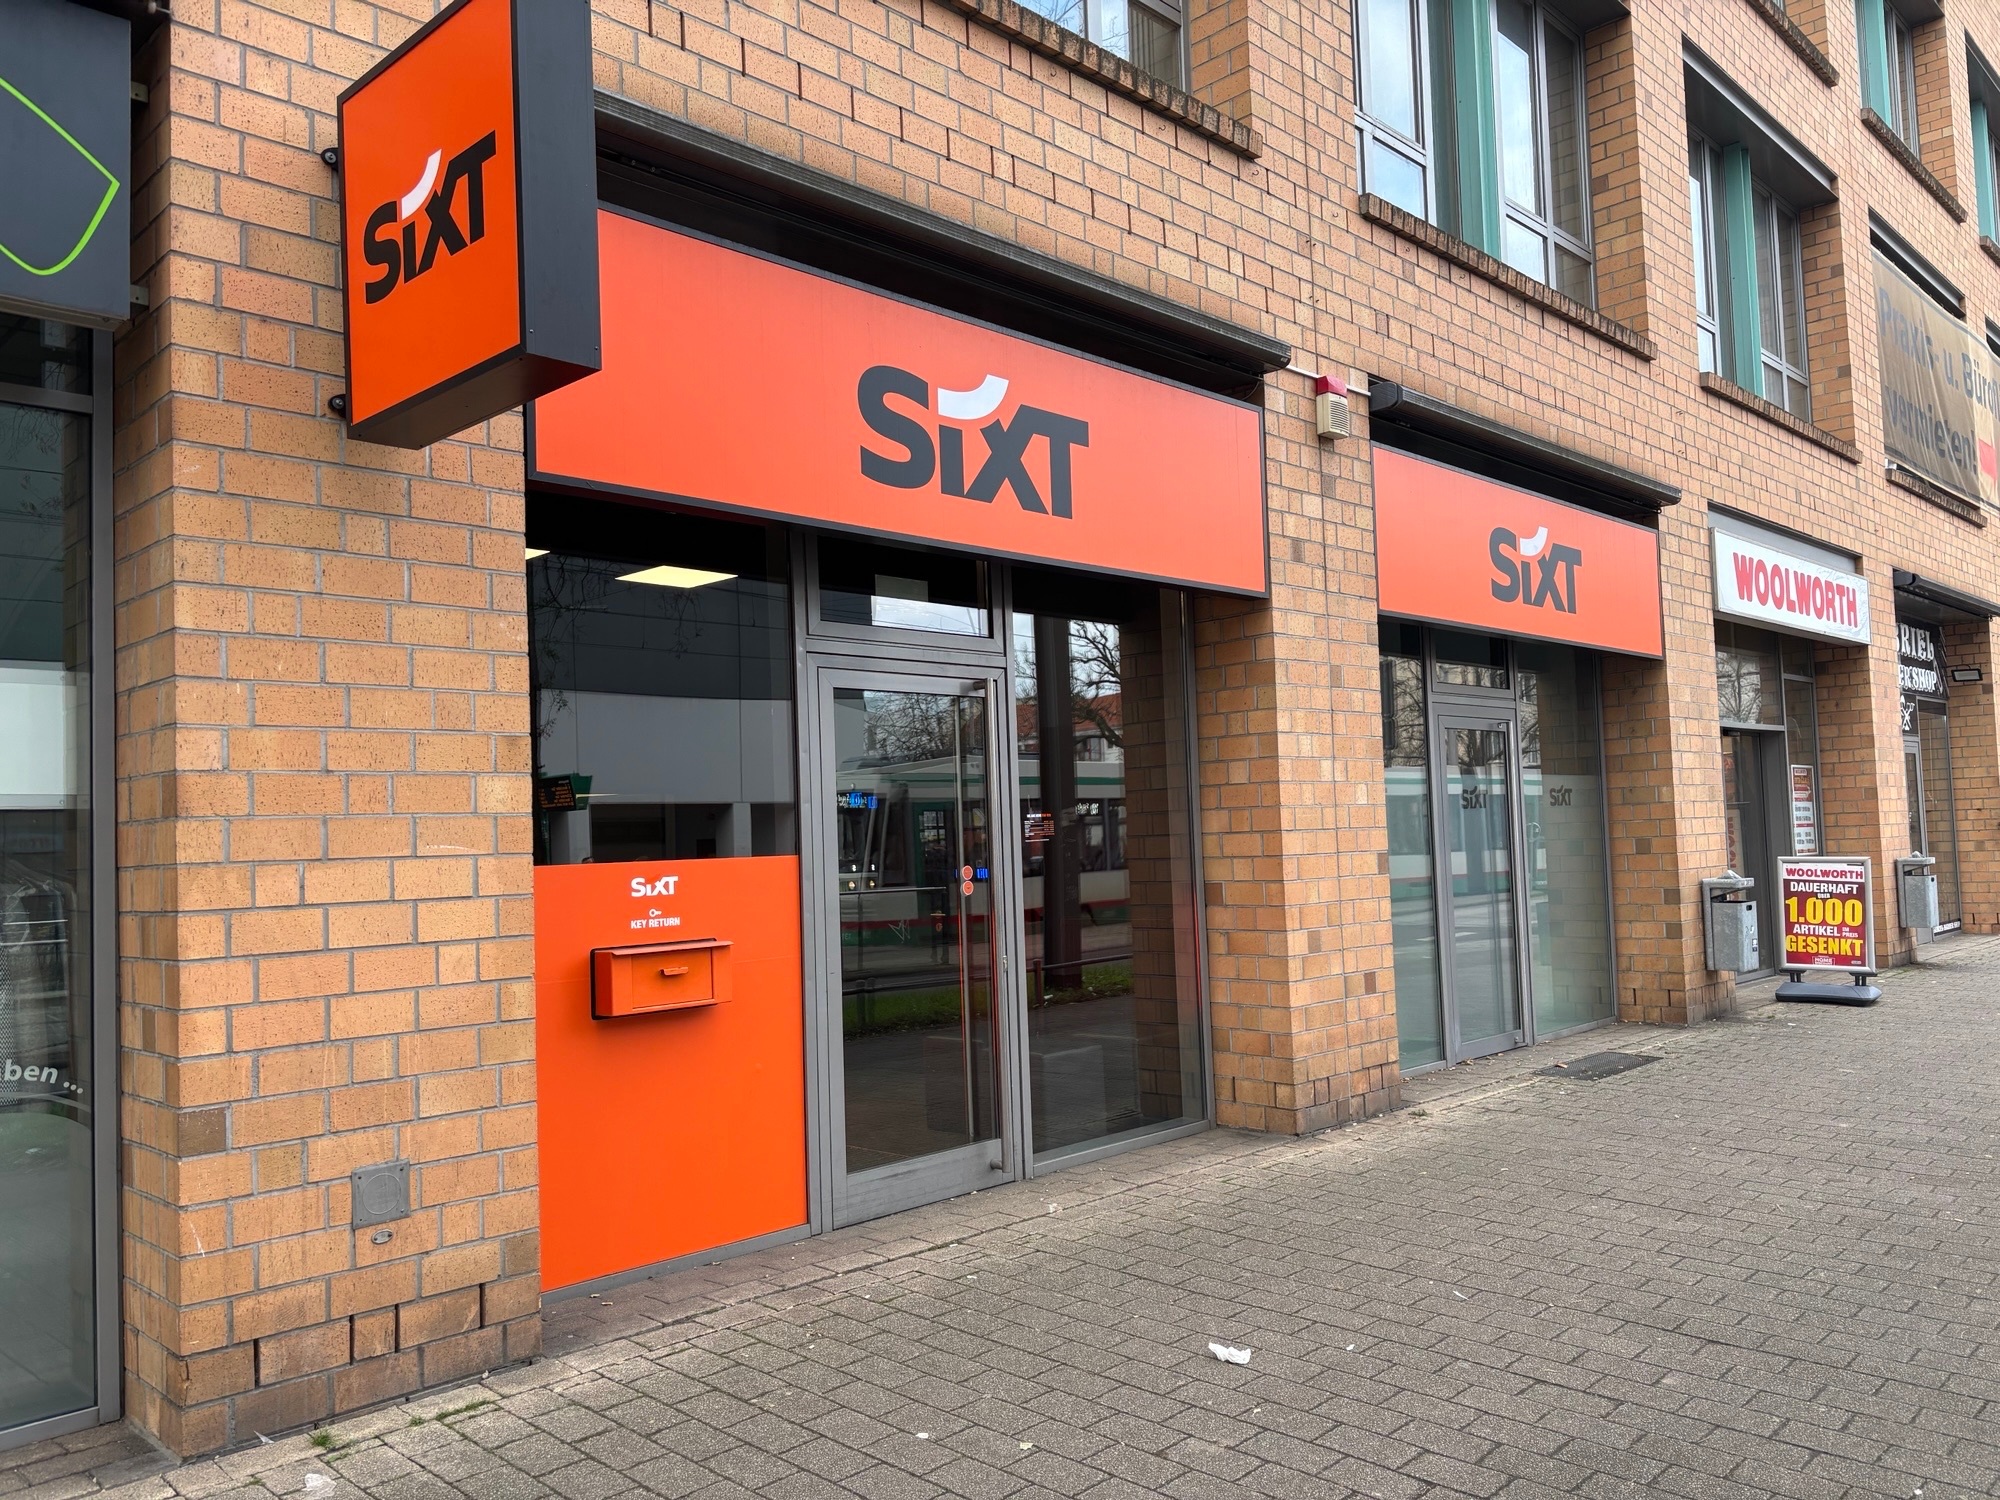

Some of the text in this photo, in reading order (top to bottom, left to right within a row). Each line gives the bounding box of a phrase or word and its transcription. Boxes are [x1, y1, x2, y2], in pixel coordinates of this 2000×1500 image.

[1732, 551, 1858, 628] WOOLWORTH
[1785, 867, 1864, 880] WOOLWORTH
[1790, 881, 1859, 895] DAUERHAFT
[1785, 896, 1863, 927] 1.000
[630, 916, 681, 929] KEY RETURN
[1792, 923, 1841, 937] ARTIKEL
[1785, 934, 1864, 957] GESENKT
